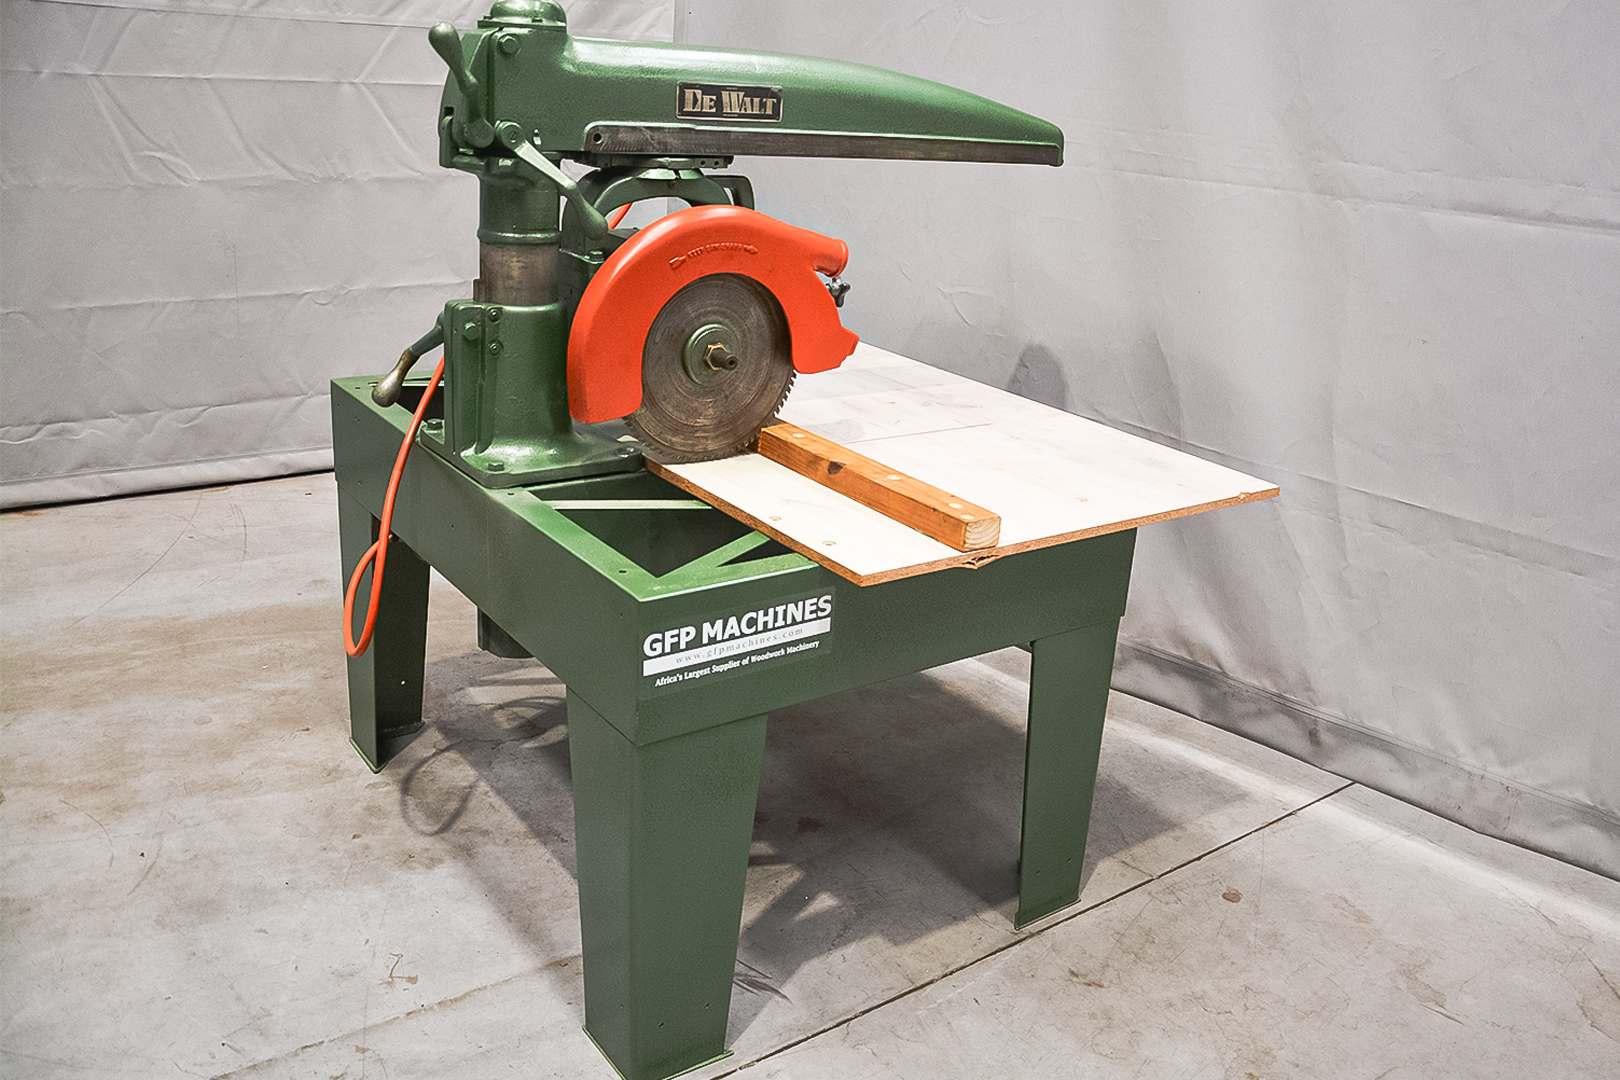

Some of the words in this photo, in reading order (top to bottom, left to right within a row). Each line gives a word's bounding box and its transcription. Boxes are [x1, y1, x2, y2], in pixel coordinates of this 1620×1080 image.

[721, 90, 777, 115] WALT
[643, 625, 696, 657] GFP
[702, 595, 832, 644] MACHINES
[675, 627, 803, 664] www.gfpmachines.com
[655, 673, 683, 687] Africa's
[684, 666, 711, 680] Largest
[711, 660, 741, 673] Supplier
[741, 656, 749, 665] of
[750, 648, 785, 662] Woodwork
[786, 640, 820, 655] Machinery
